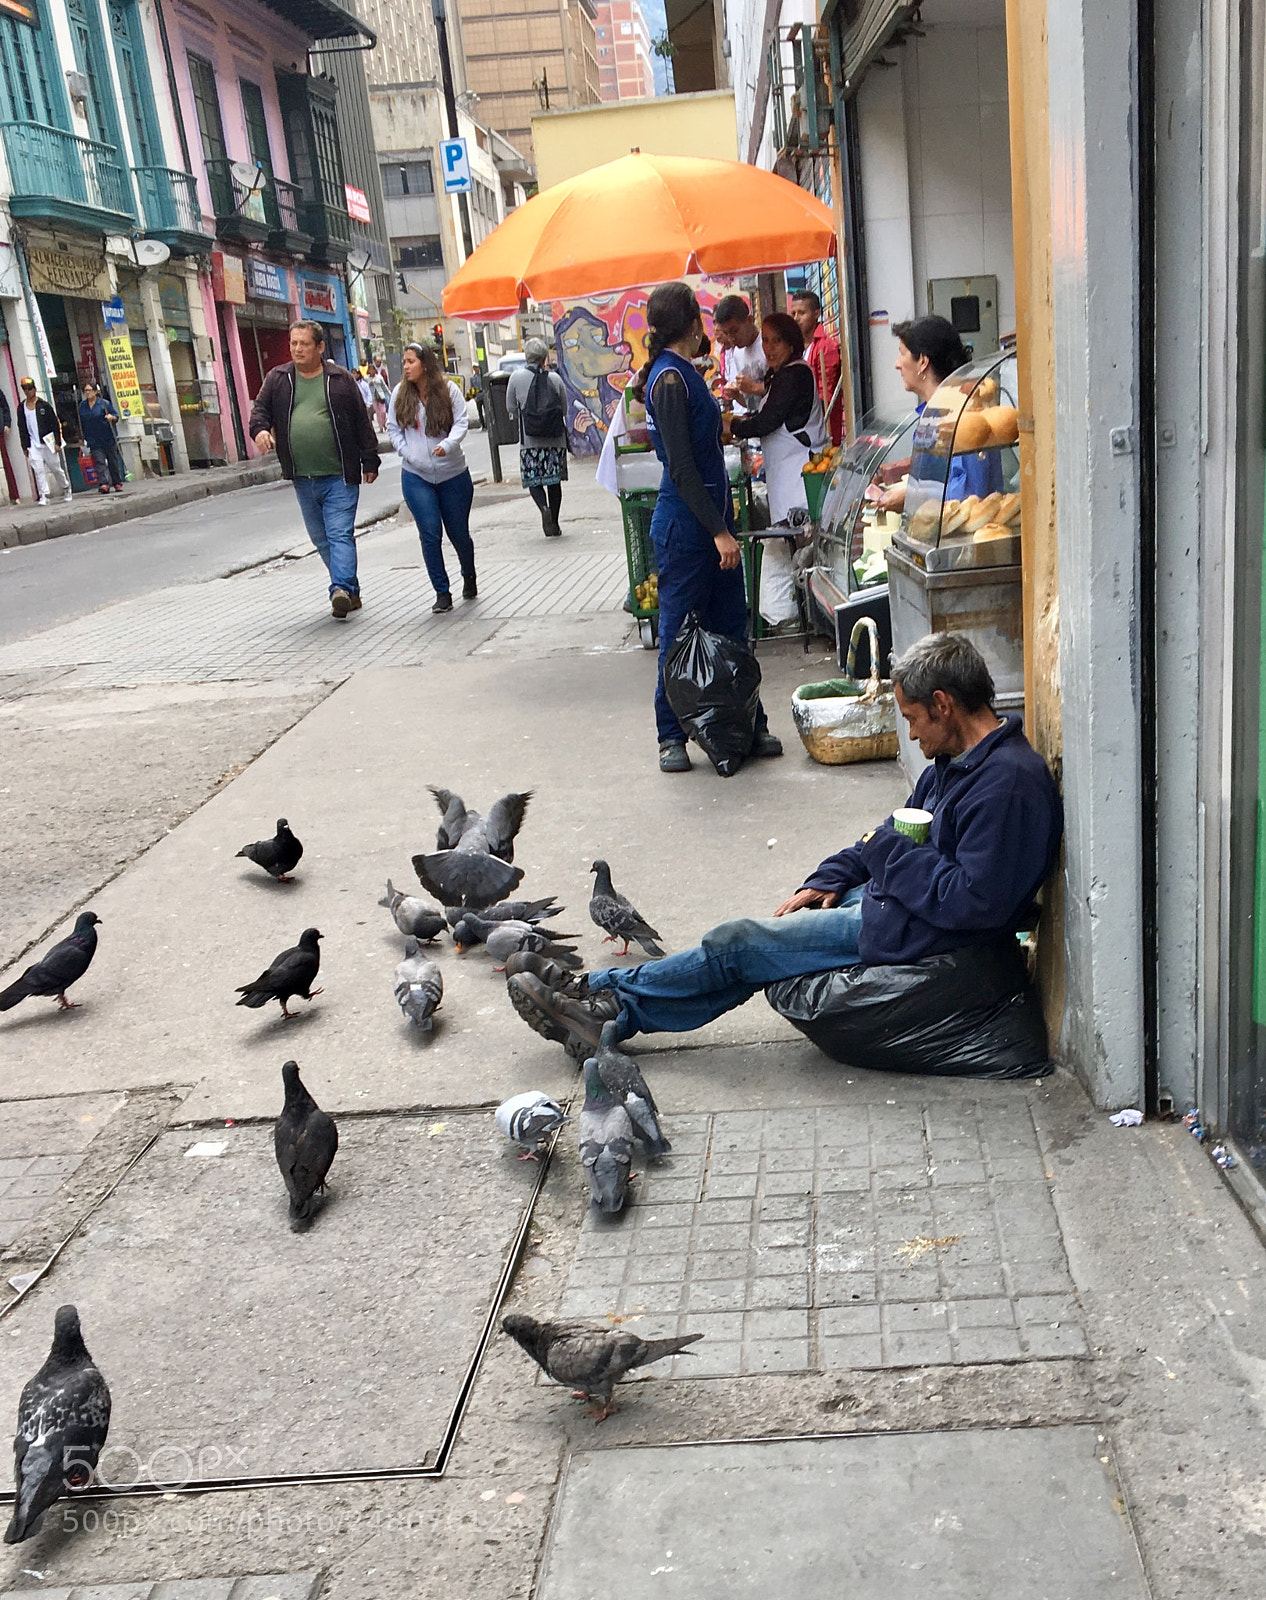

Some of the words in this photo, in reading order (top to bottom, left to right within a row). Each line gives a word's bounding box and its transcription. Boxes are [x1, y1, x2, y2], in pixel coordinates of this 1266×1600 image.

[445, 144, 463, 172] P
[47, 266, 97, 288] HERNANDEZ
[110, 346, 126, 354] LOCAL
[108, 354, 132, 362] NACIONAL
[112, 371, 136, 381] RECARGAS
[115, 381, 122, 389] EN
[123, 380, 137, 388] LINEA
[116, 389, 140, 398] CELULAR
